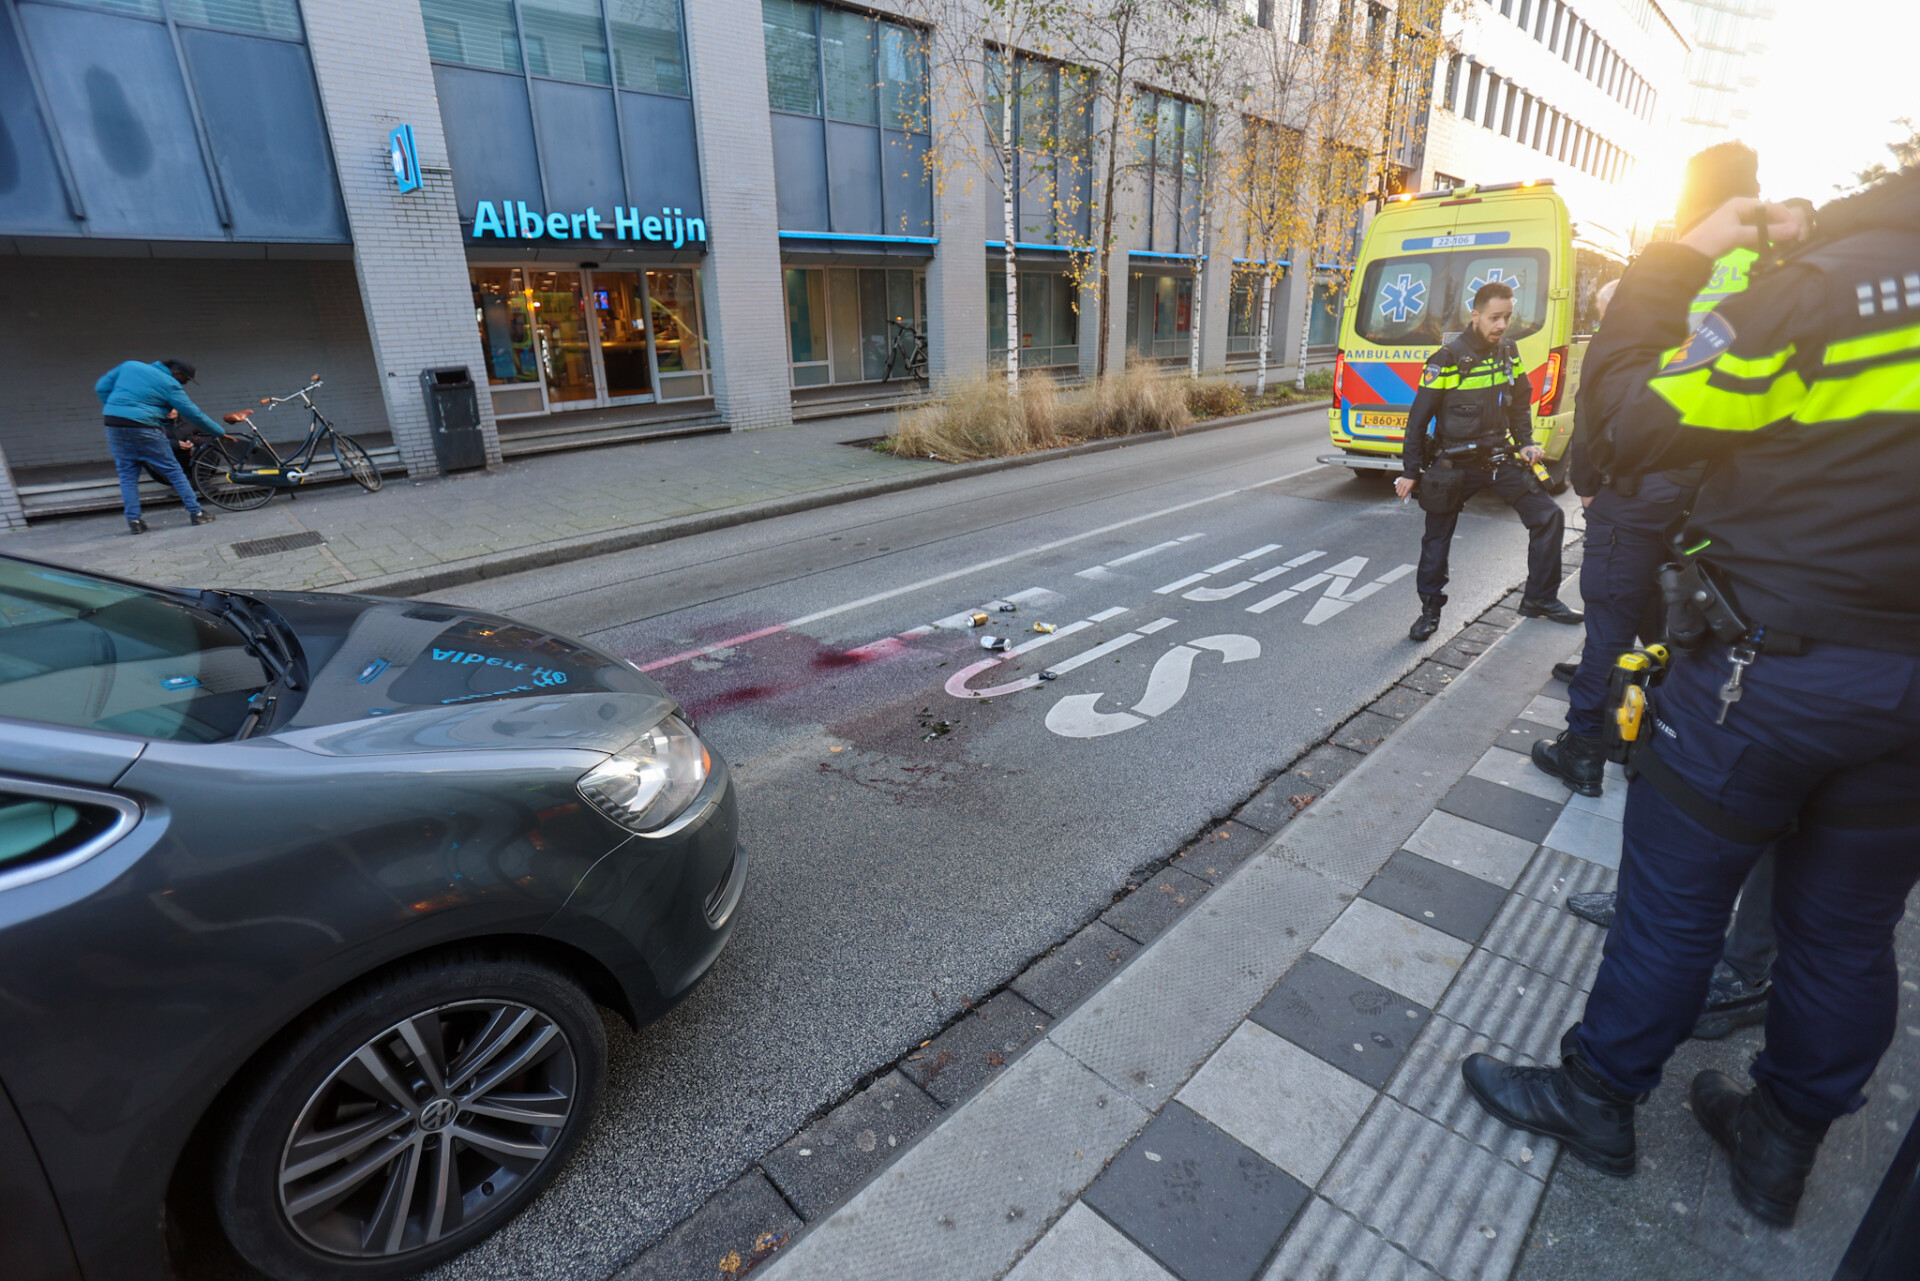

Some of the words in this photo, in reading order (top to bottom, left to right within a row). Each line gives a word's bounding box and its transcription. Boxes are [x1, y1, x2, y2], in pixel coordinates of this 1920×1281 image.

[473, 200, 603, 240] Albert
[614, 206, 706, 249] Heijn
[1438, 236, 1470, 246] 22-106
[1345, 349, 1431, 359] AMBULANCE
